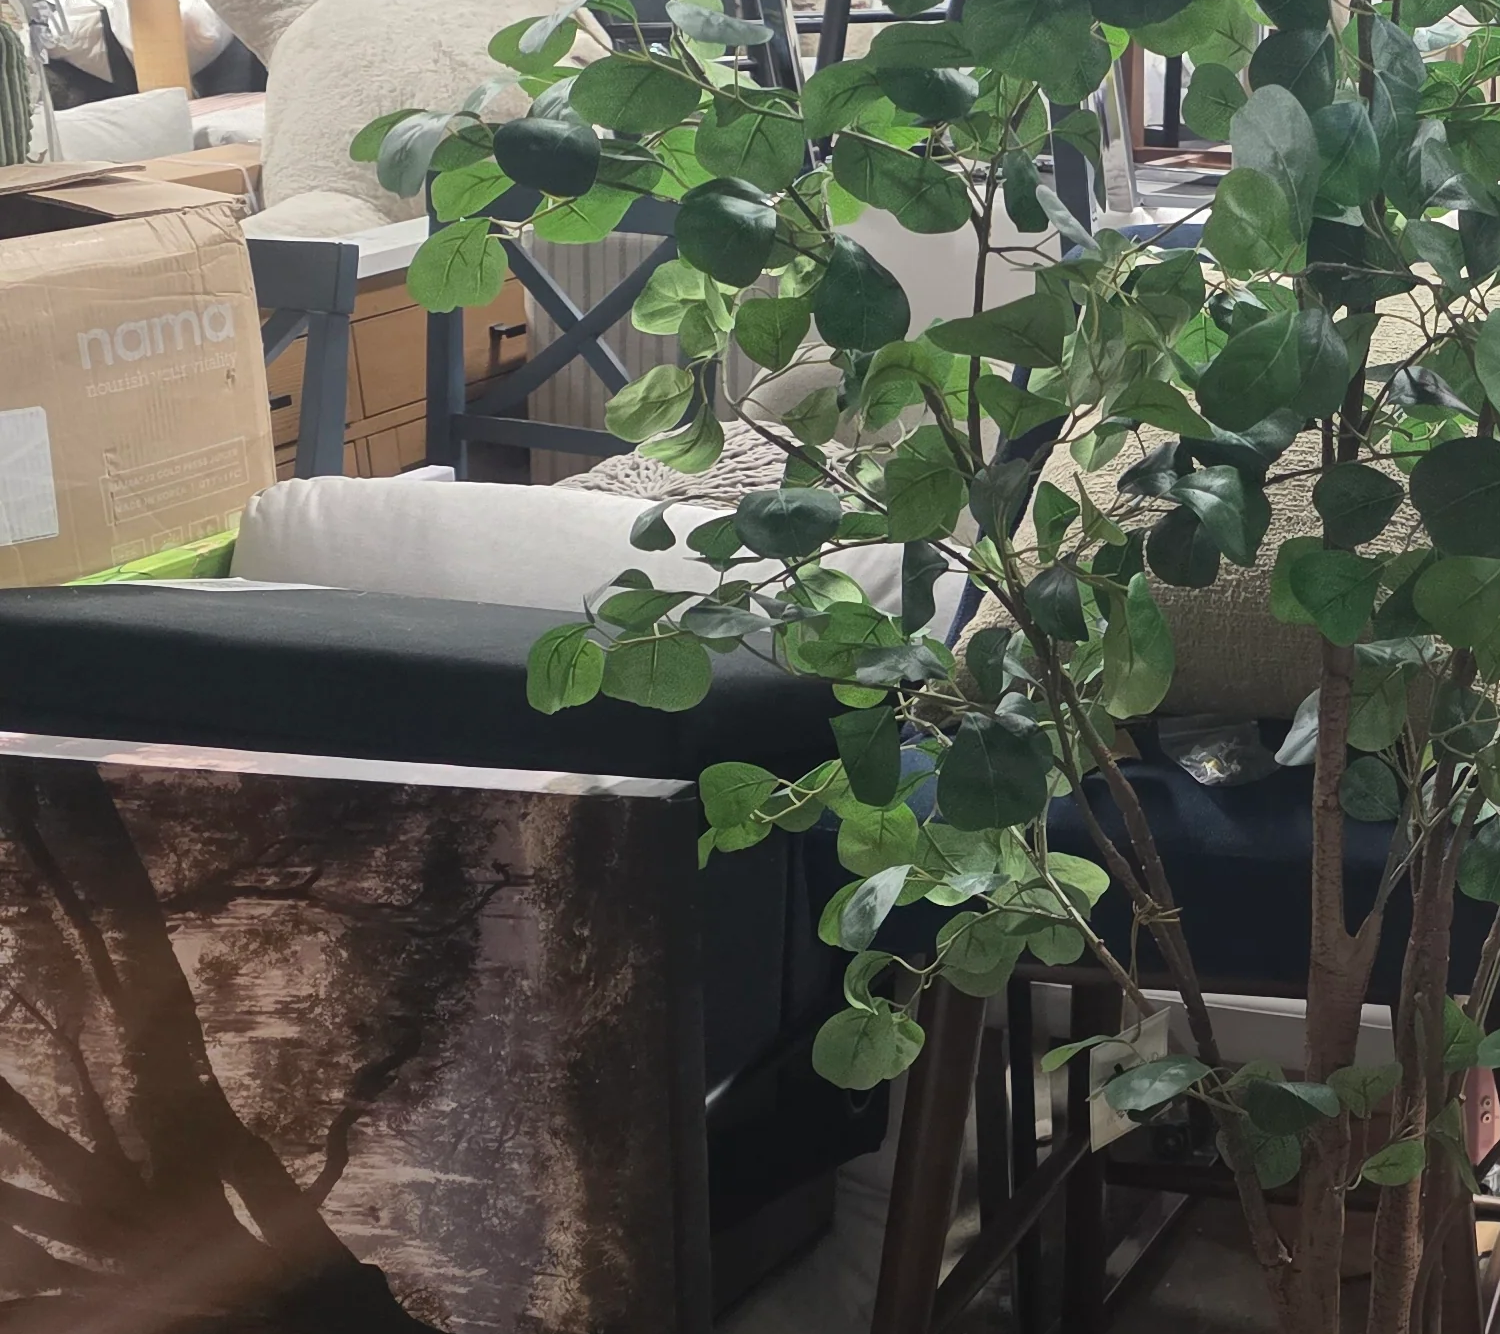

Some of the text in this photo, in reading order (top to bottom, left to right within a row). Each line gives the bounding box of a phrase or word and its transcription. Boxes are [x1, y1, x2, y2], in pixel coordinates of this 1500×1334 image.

[77, 303, 235, 370] nama
[85, 352, 237, 398] nourish your vitality
